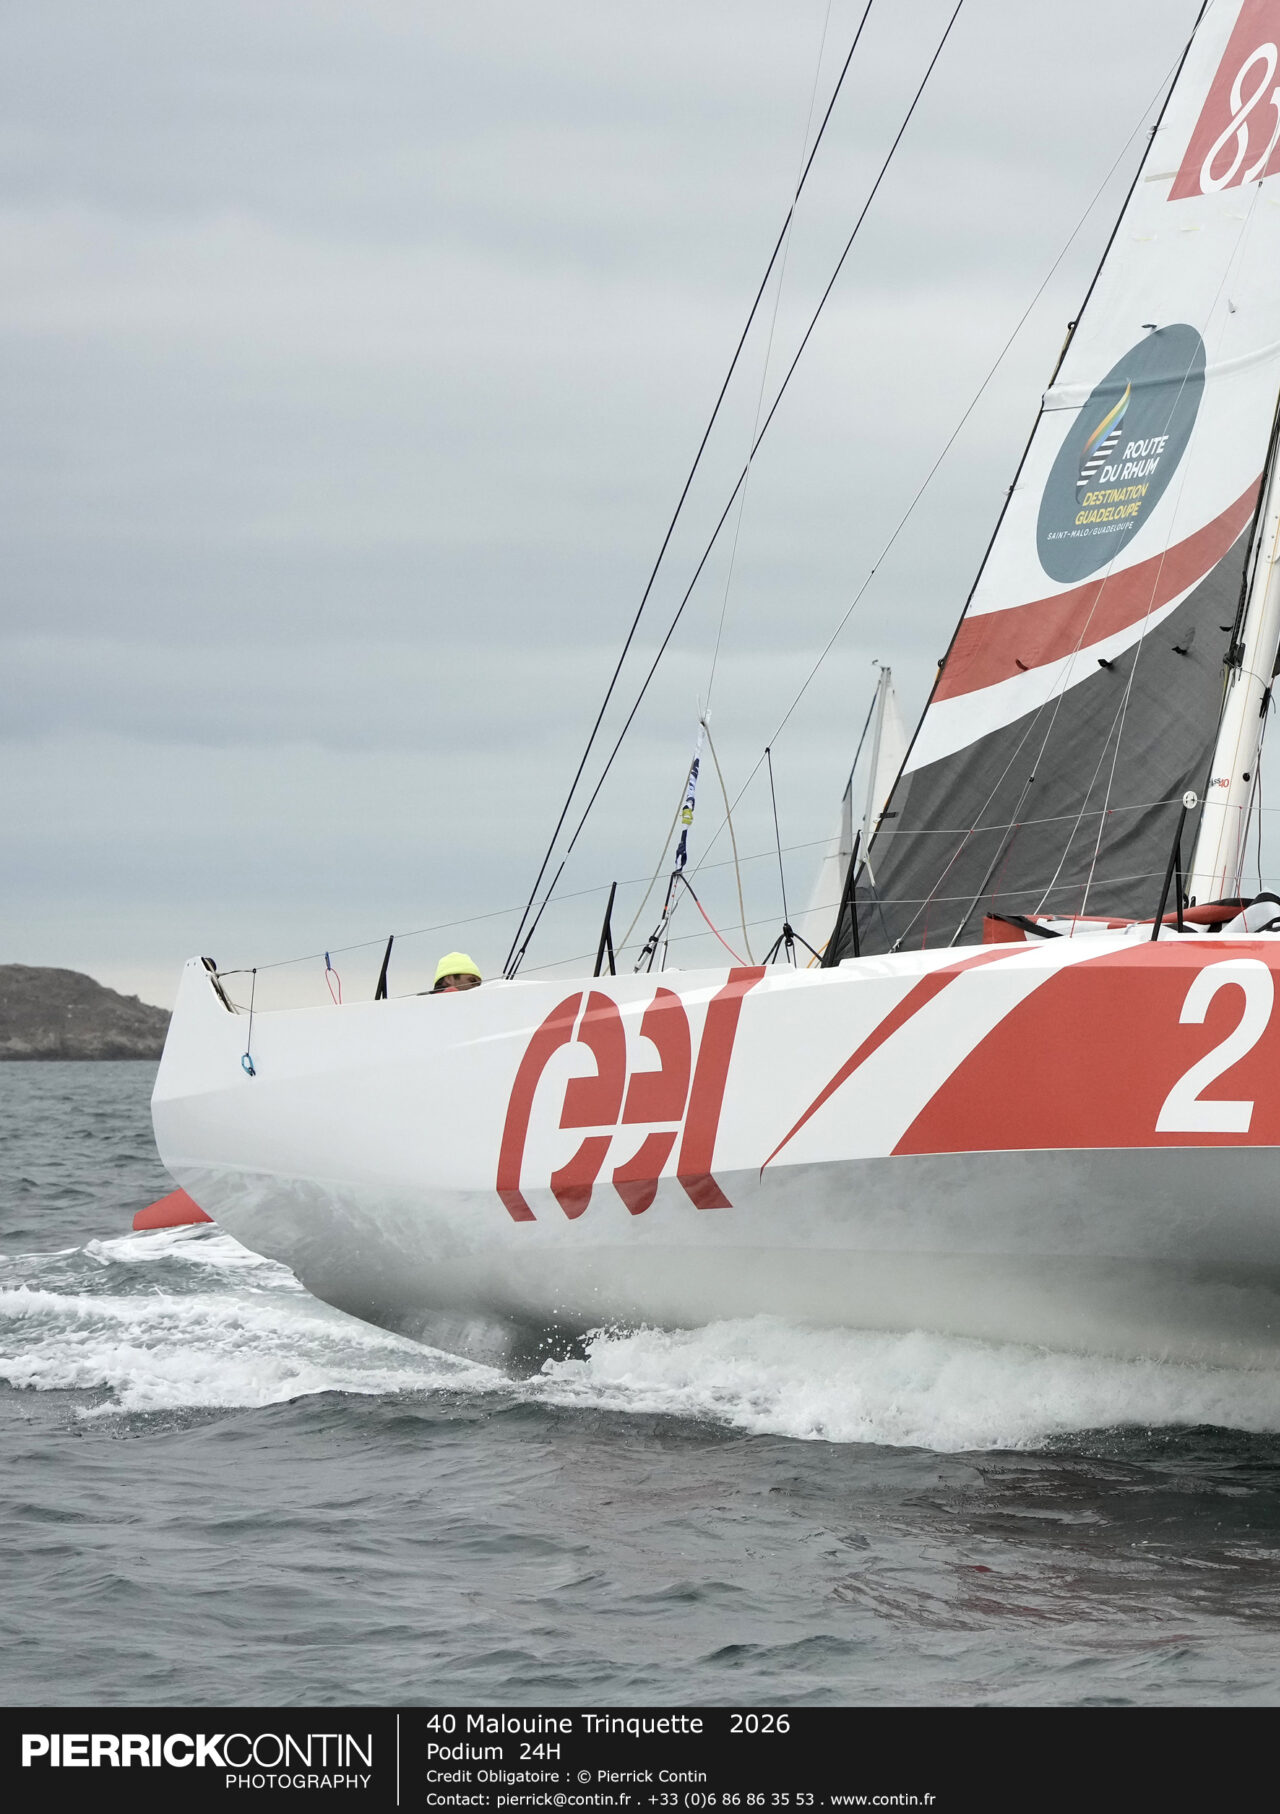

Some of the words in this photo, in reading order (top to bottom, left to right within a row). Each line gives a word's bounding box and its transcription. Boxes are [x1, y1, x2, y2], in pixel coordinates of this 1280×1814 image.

[1122, 435, 1169, 460] ROUTE
[1099, 464, 1123, 483] DU
[1120, 457, 1160, 481] RHUM
[1082, 482, 1149, 507] DESTINATION
[1075, 502, 1142, 525] GUADELOUPE
